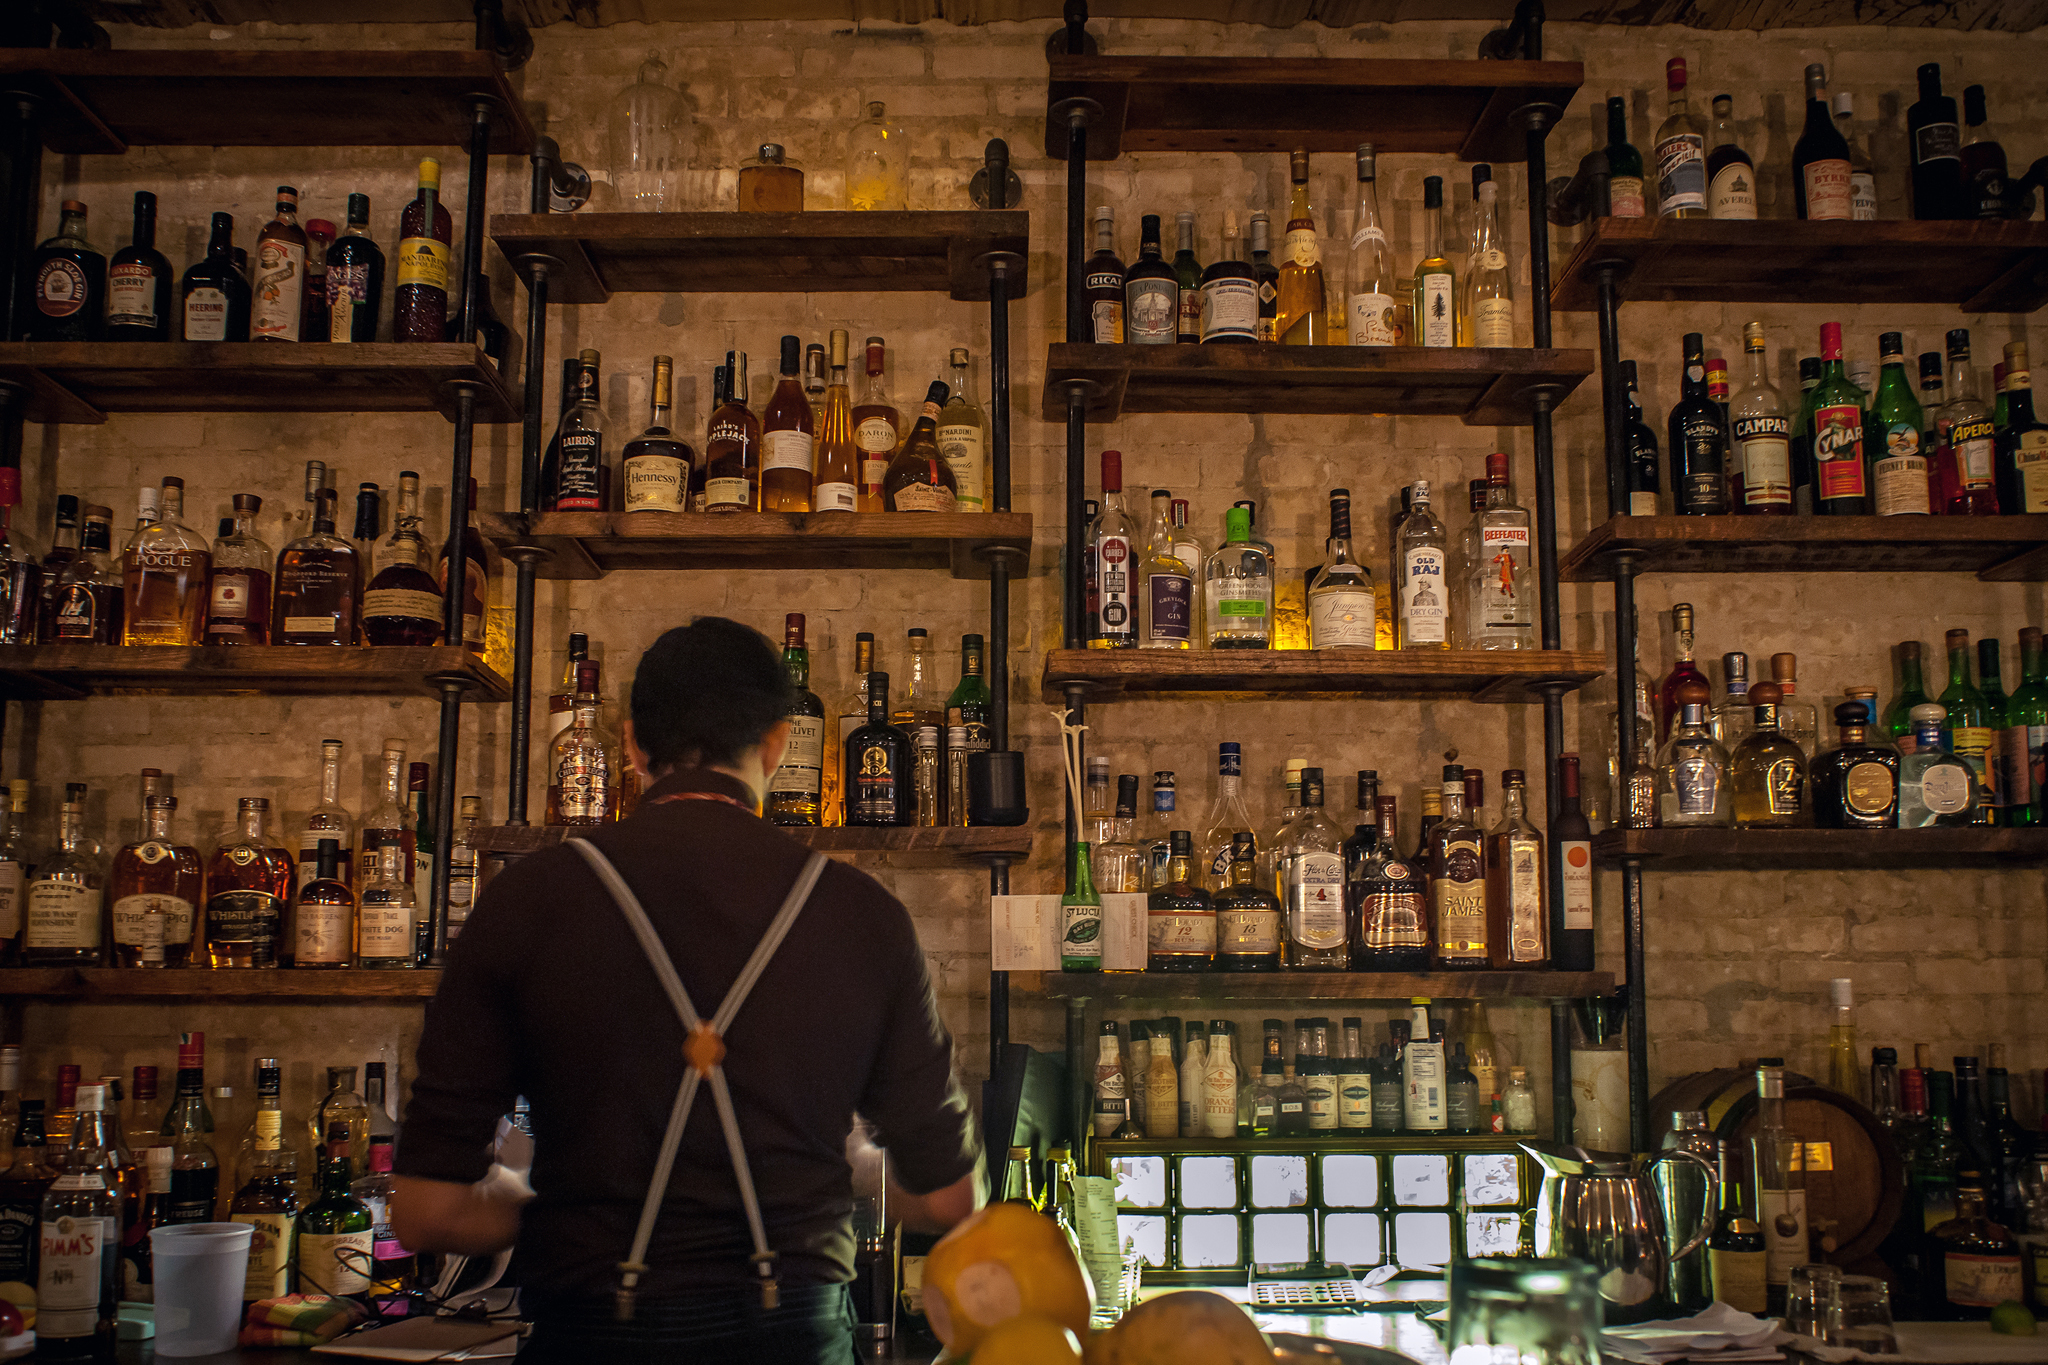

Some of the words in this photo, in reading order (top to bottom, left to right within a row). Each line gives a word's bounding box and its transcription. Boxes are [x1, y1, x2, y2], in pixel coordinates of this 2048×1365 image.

[37, 261, 63, 298] PLYMOUTH
[73, 281, 84, 300] GIN
[112, 278, 146, 288] CHERRY
[189, 303, 223, 312] HEERING
[858, 429, 894, 440] DARON
[563, 434, 596, 448] LAIRD'S
[1814, 426, 1863, 461] CYNAR
[631, 473, 678, 485] Hennessy
[1699, 484, 1710, 493] 10
[1484, 530, 1527, 542] BEEFEATER
[135, 554, 192, 567] POGUE
[1412, 565, 1440, 576] RAJ
[1108, 608, 1122, 621] GIN
[1168, 612, 1181, 620] GIN
[1410, 608, 1427, 616] DRY
[789, 727, 816, 737] NLIVET
[788, 741, 798, 750] 12
[586, 766, 609, 778] REGAL
[1316, 888, 1327, 901] 4
[1444, 896, 1483, 906] SAINT
[209, 910, 254, 921] WHISTL
[1442, 906, 1484, 917] JAMES
[385, 926, 404, 934] DOG
[1178, 927, 1192, 936] 12
[1242, 924, 1257, 934] 15
[1205, 1098, 1236, 1106] ORANGE
[1205, 1106, 1236, 1114] BITTERS
[43, 1234, 95, 1257] PIMM'S
